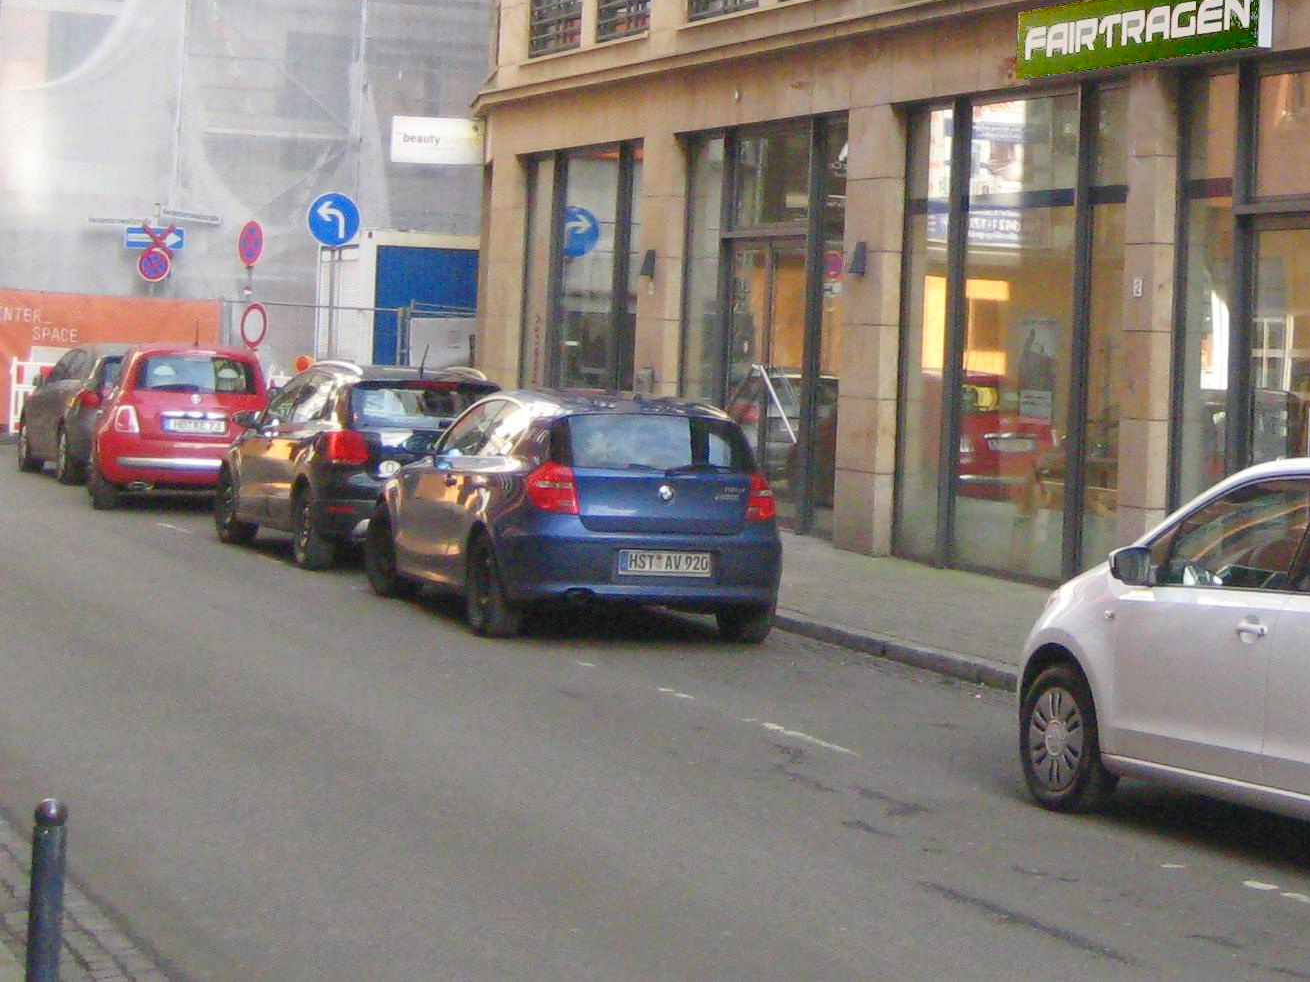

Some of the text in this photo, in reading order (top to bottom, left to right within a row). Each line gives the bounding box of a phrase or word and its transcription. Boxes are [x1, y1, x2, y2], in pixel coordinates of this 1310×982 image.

[32, 325, 79, 343] SPACE
[629, 553, 708, 571] HST AV 920
